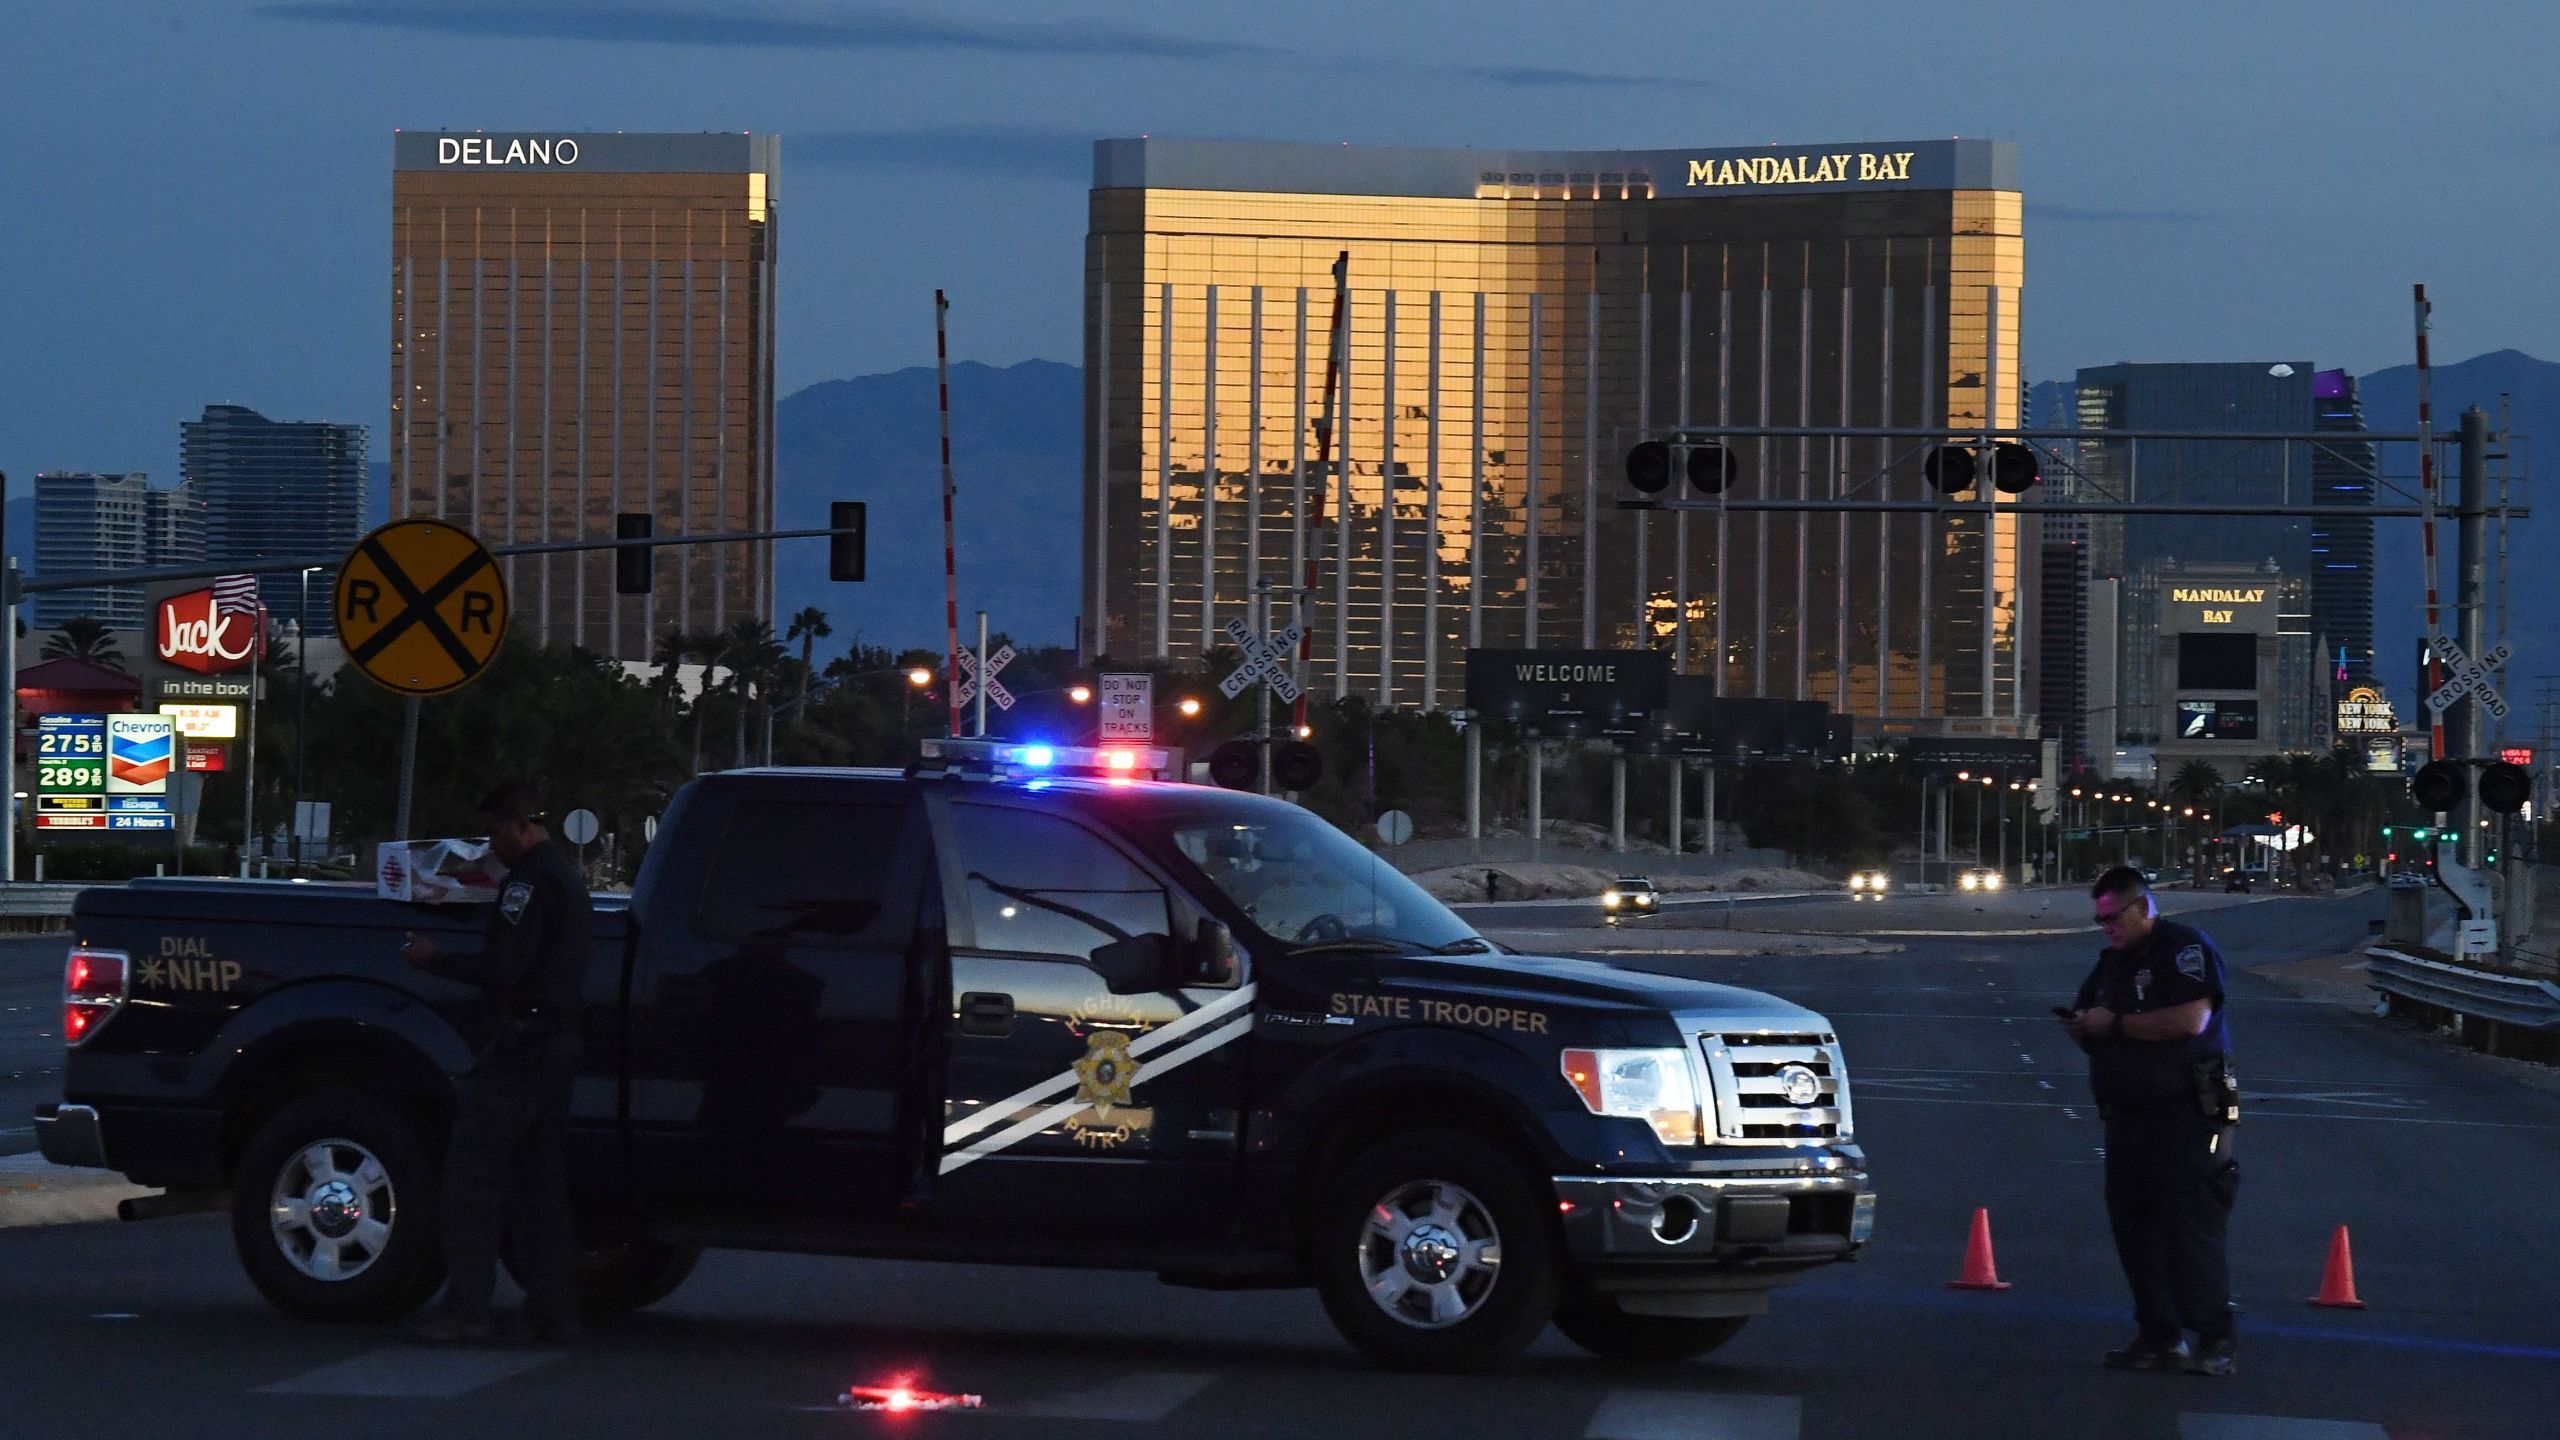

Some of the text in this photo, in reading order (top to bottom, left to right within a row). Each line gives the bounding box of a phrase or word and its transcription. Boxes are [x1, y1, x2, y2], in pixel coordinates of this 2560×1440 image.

[438, 138, 579, 165] DELANO
[1686, 152, 1915, 187] MANDALAY BAY
[347, 578, 381, 623] R
[2172, 588, 2265, 603] MANDALAY
[461, 590, 495, 635] R
[2202, 610, 2234, 623] BAY
[160, 599, 254, 660] Jack
[1228, 620, 1256, 653] RAIL
[1226, 629, 1298, 692] CROSSING
[2434, 636, 2463, 669] RAIL
[1104, 680, 1148, 690] DO NOT
[1265, 666, 1297, 700] ROAD
[1515, 664, 1616, 683] WELCOME
[2432, 646, 2508, 708] CROSSING
[164, 680, 249, 695] in the box
[986, 680, 1012, 707] ROAD
[1113, 694, 1140, 705] STOP
[2473, 682, 2506, 717] ROAD
[112, 721, 171, 733] Chevron
[1119, 708, 1134, 719] ON
[1104, 722, 1149, 733] TRACKS
[40, 734, 90, 752] 275
[40, 767, 90, 786] 289
[115, 817, 166, 827] 24 Hours
[161, 936, 213, 958] DIAL
[1330, 993, 1412, 1020] STATE
[1419, 999, 1549, 1034] TROOPER
[1064, 1117, 1140, 1149] PATROL
